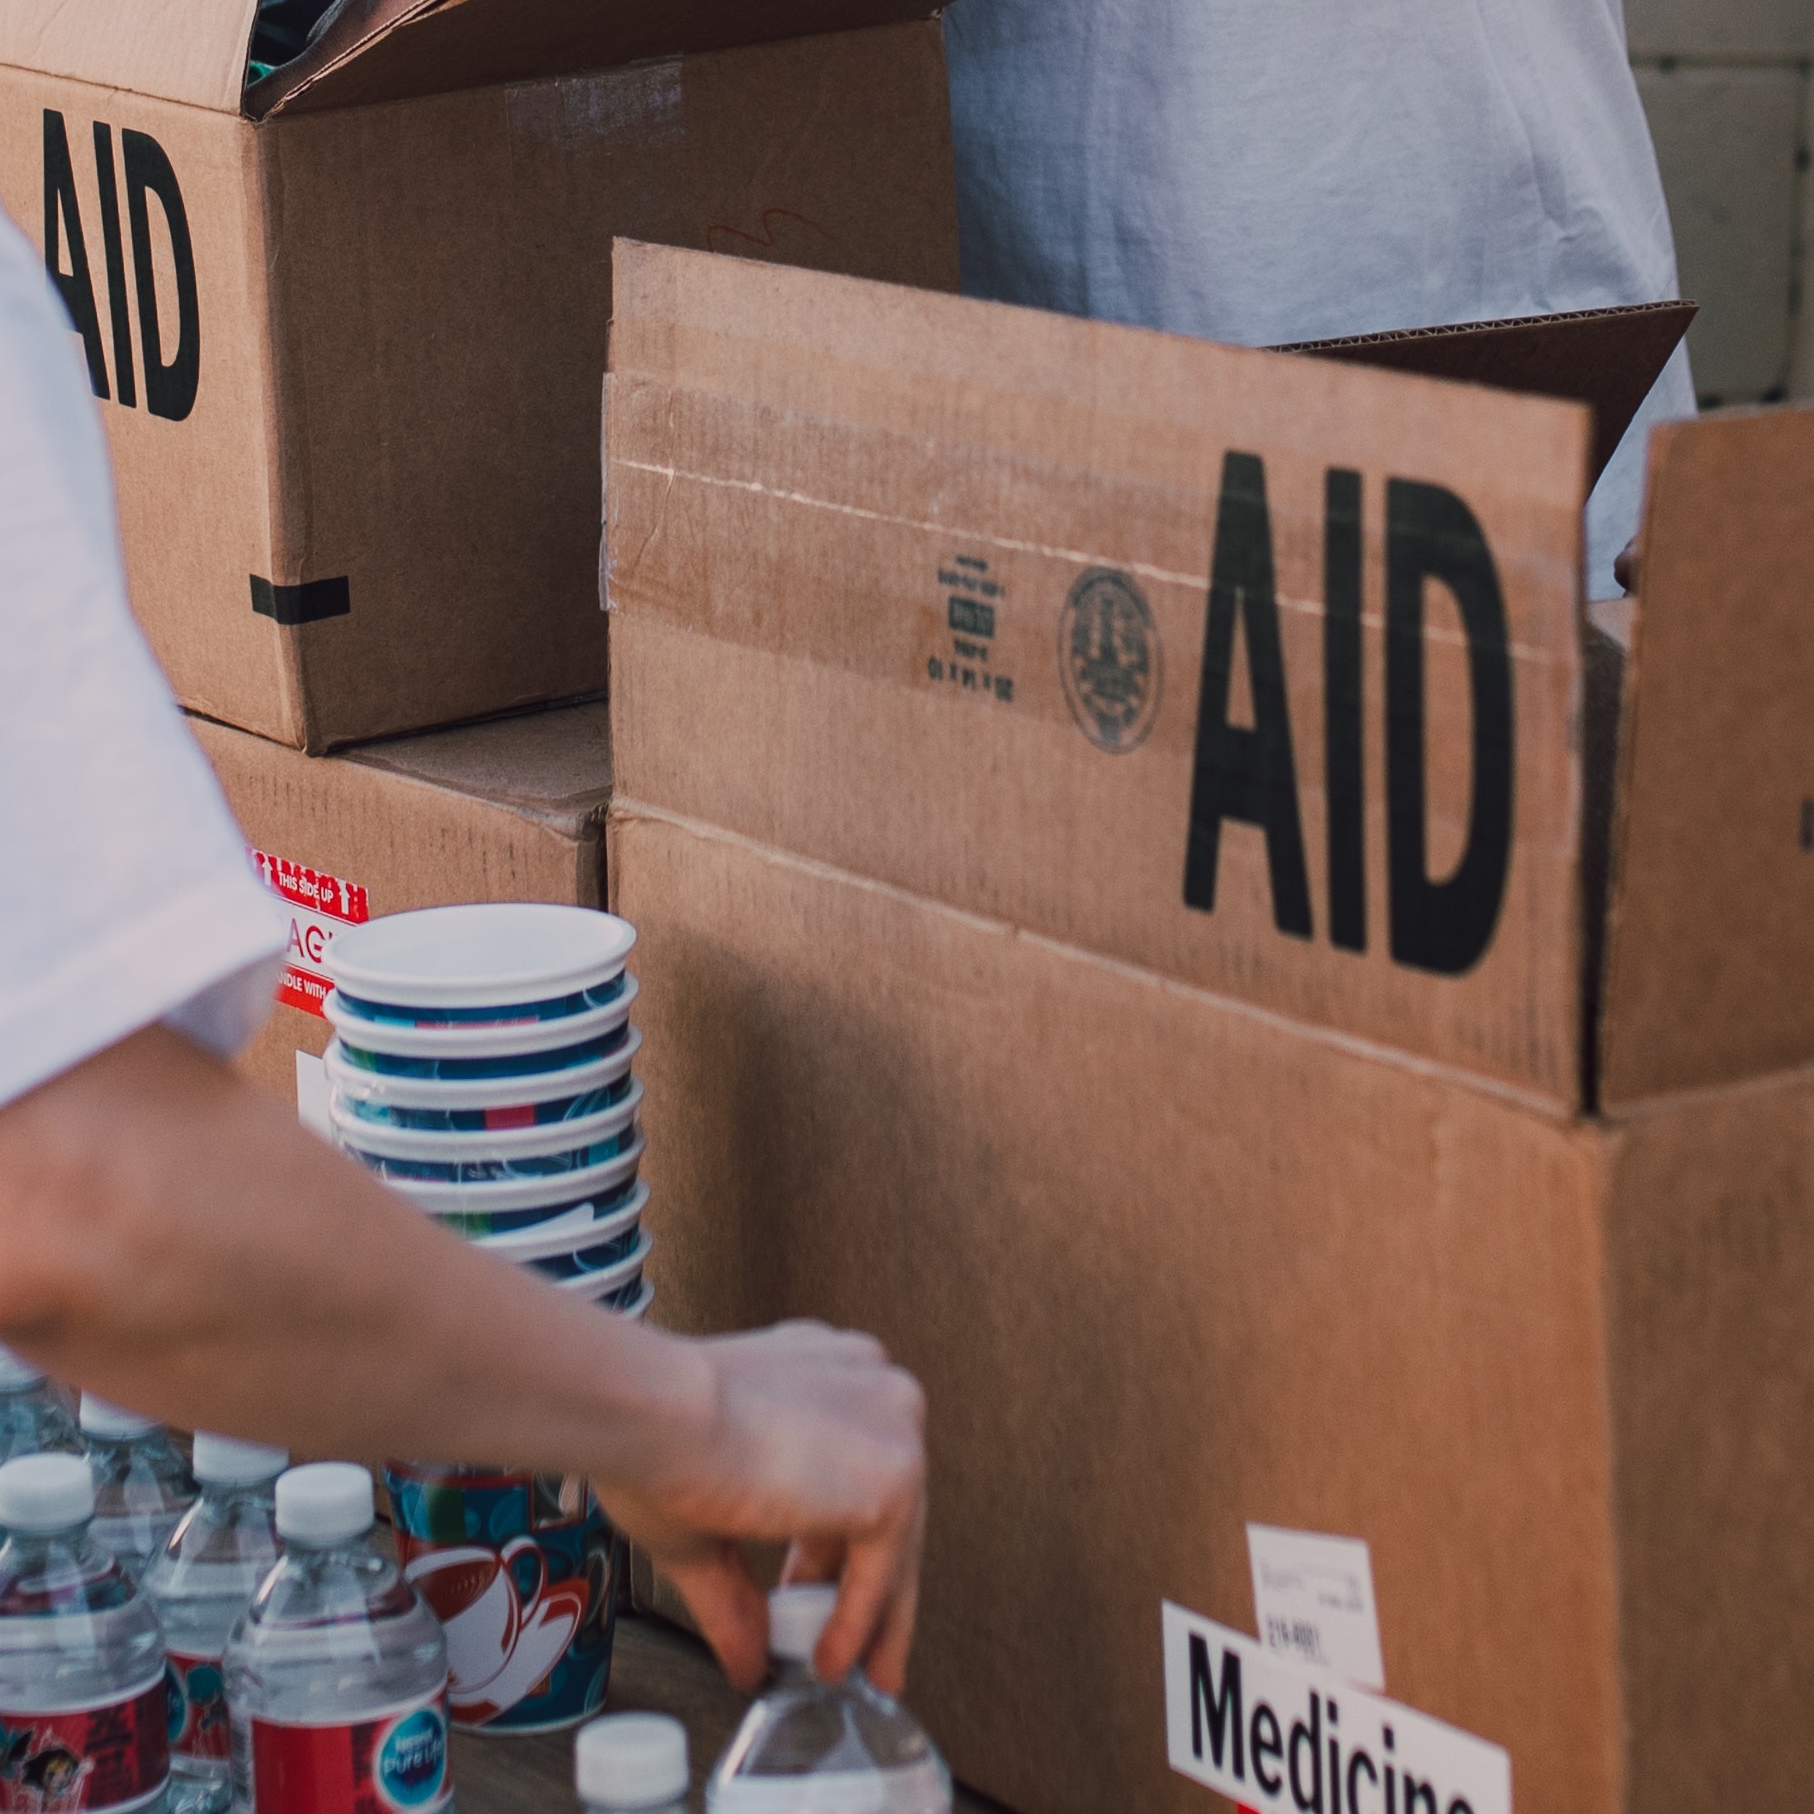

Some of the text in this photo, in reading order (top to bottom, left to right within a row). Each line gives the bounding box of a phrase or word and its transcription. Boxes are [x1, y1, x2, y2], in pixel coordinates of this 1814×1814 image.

[43, 108, 200, 421] AID
[1184, 449, 1516, 980] AID
[279, 873, 334, 903] THIS SIDE UP
[280, 971, 326, 1000] NDLE WITH
[1188, 1632, 1476, 1814] Medici
